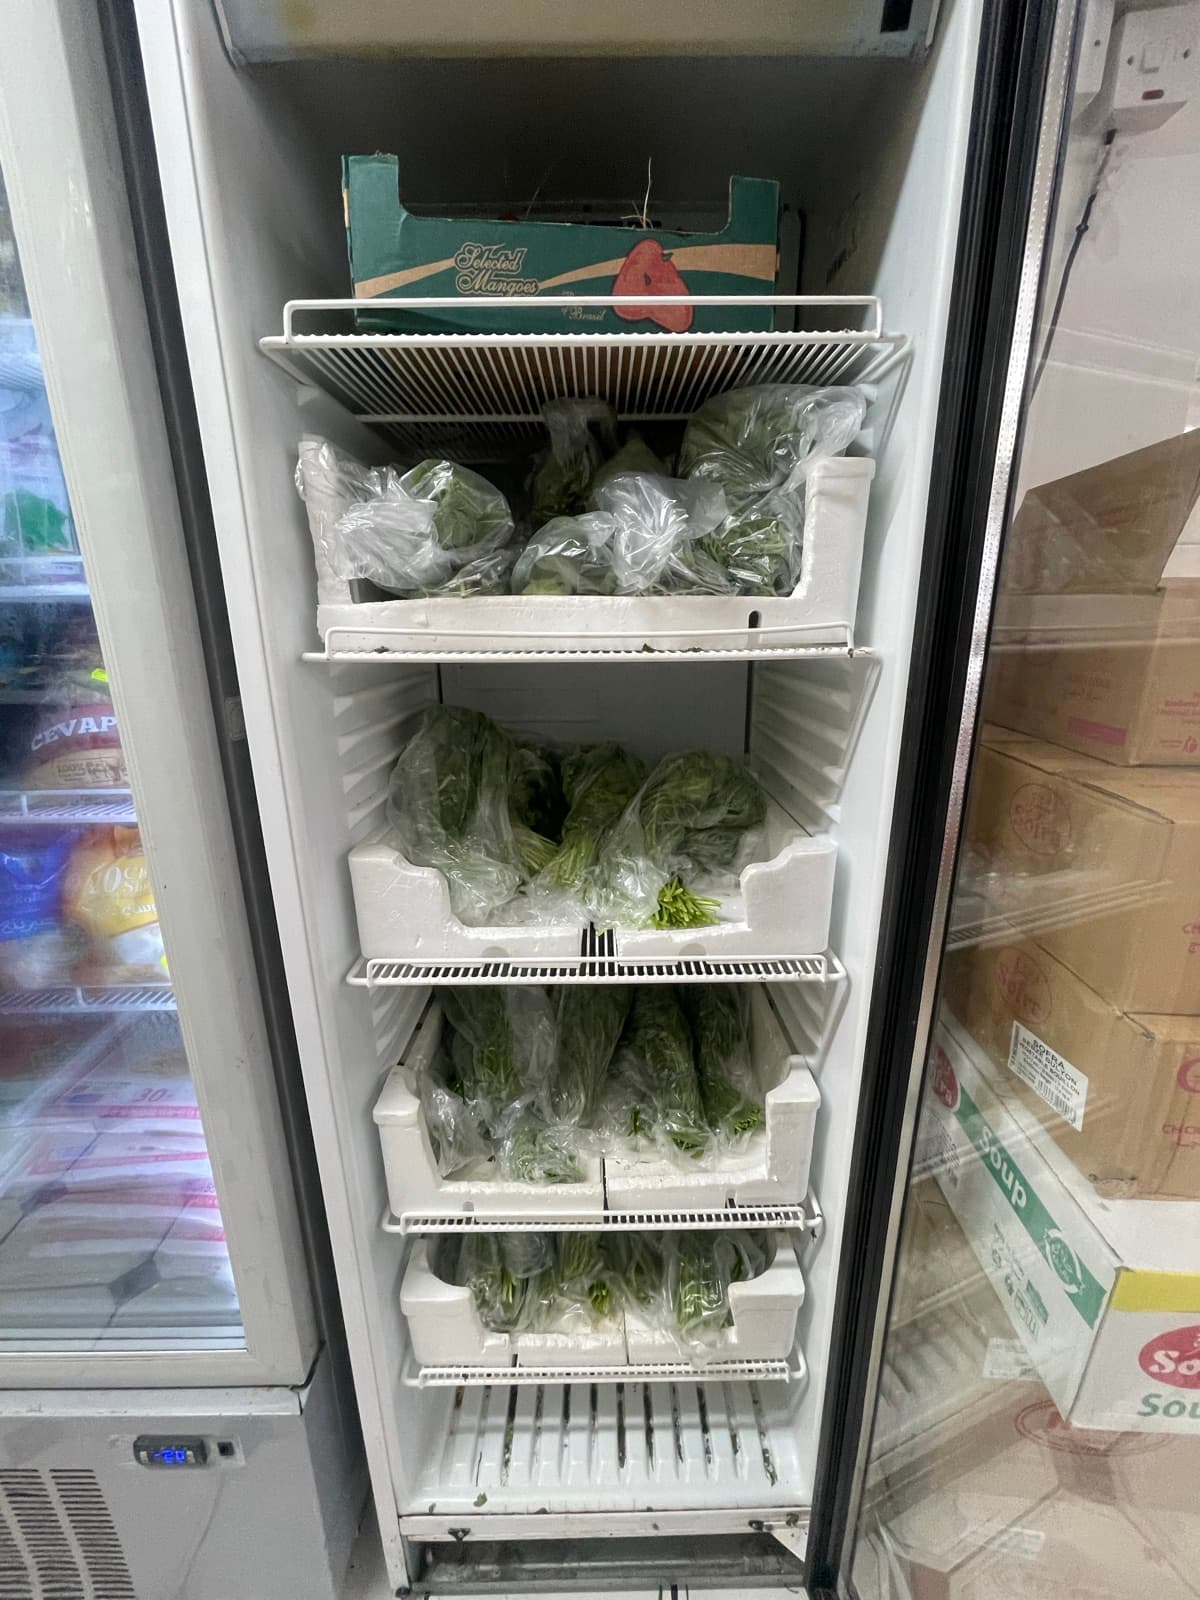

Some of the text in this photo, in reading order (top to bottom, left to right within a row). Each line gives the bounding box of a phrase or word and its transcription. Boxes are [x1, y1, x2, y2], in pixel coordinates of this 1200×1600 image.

[456, 243, 526, 273] Selected
[457, 272, 538, 296] Mangoes
[31, 716, 117, 751] CEVAP
[1032, 1038, 1065, 1070] SOFRA
[978, 1125, 1028, 1210] Soup
[1149, 1349, 1200, 1376] So
